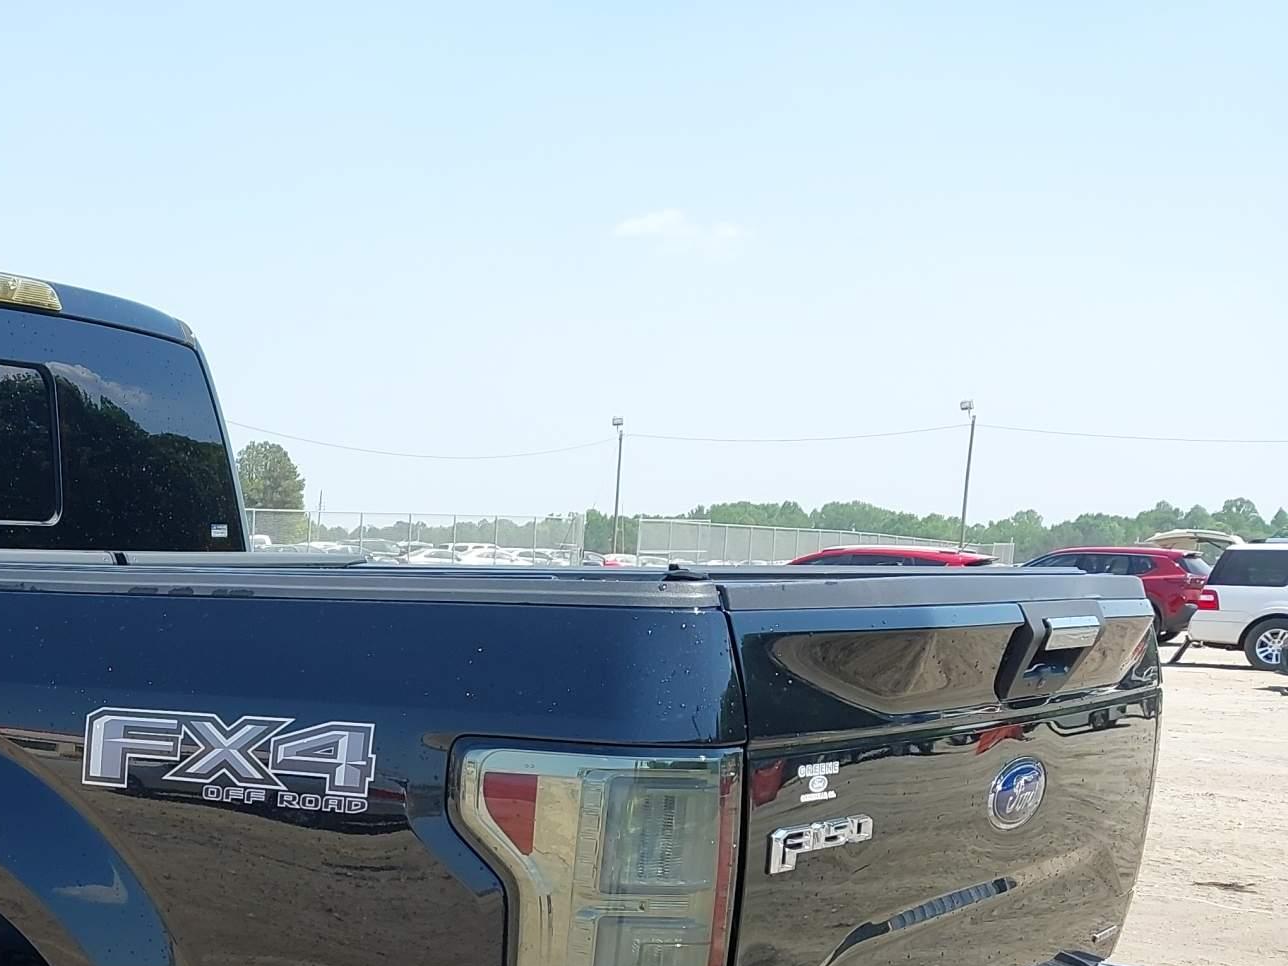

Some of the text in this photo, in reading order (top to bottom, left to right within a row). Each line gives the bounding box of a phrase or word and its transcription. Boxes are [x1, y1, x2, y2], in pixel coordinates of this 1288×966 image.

[82, 707, 376, 798] FX4
[798, 761, 840, 777] GREENE
[202, 785, 368, 814] OFF ROAD
[768, 814, 873, 874] F150
